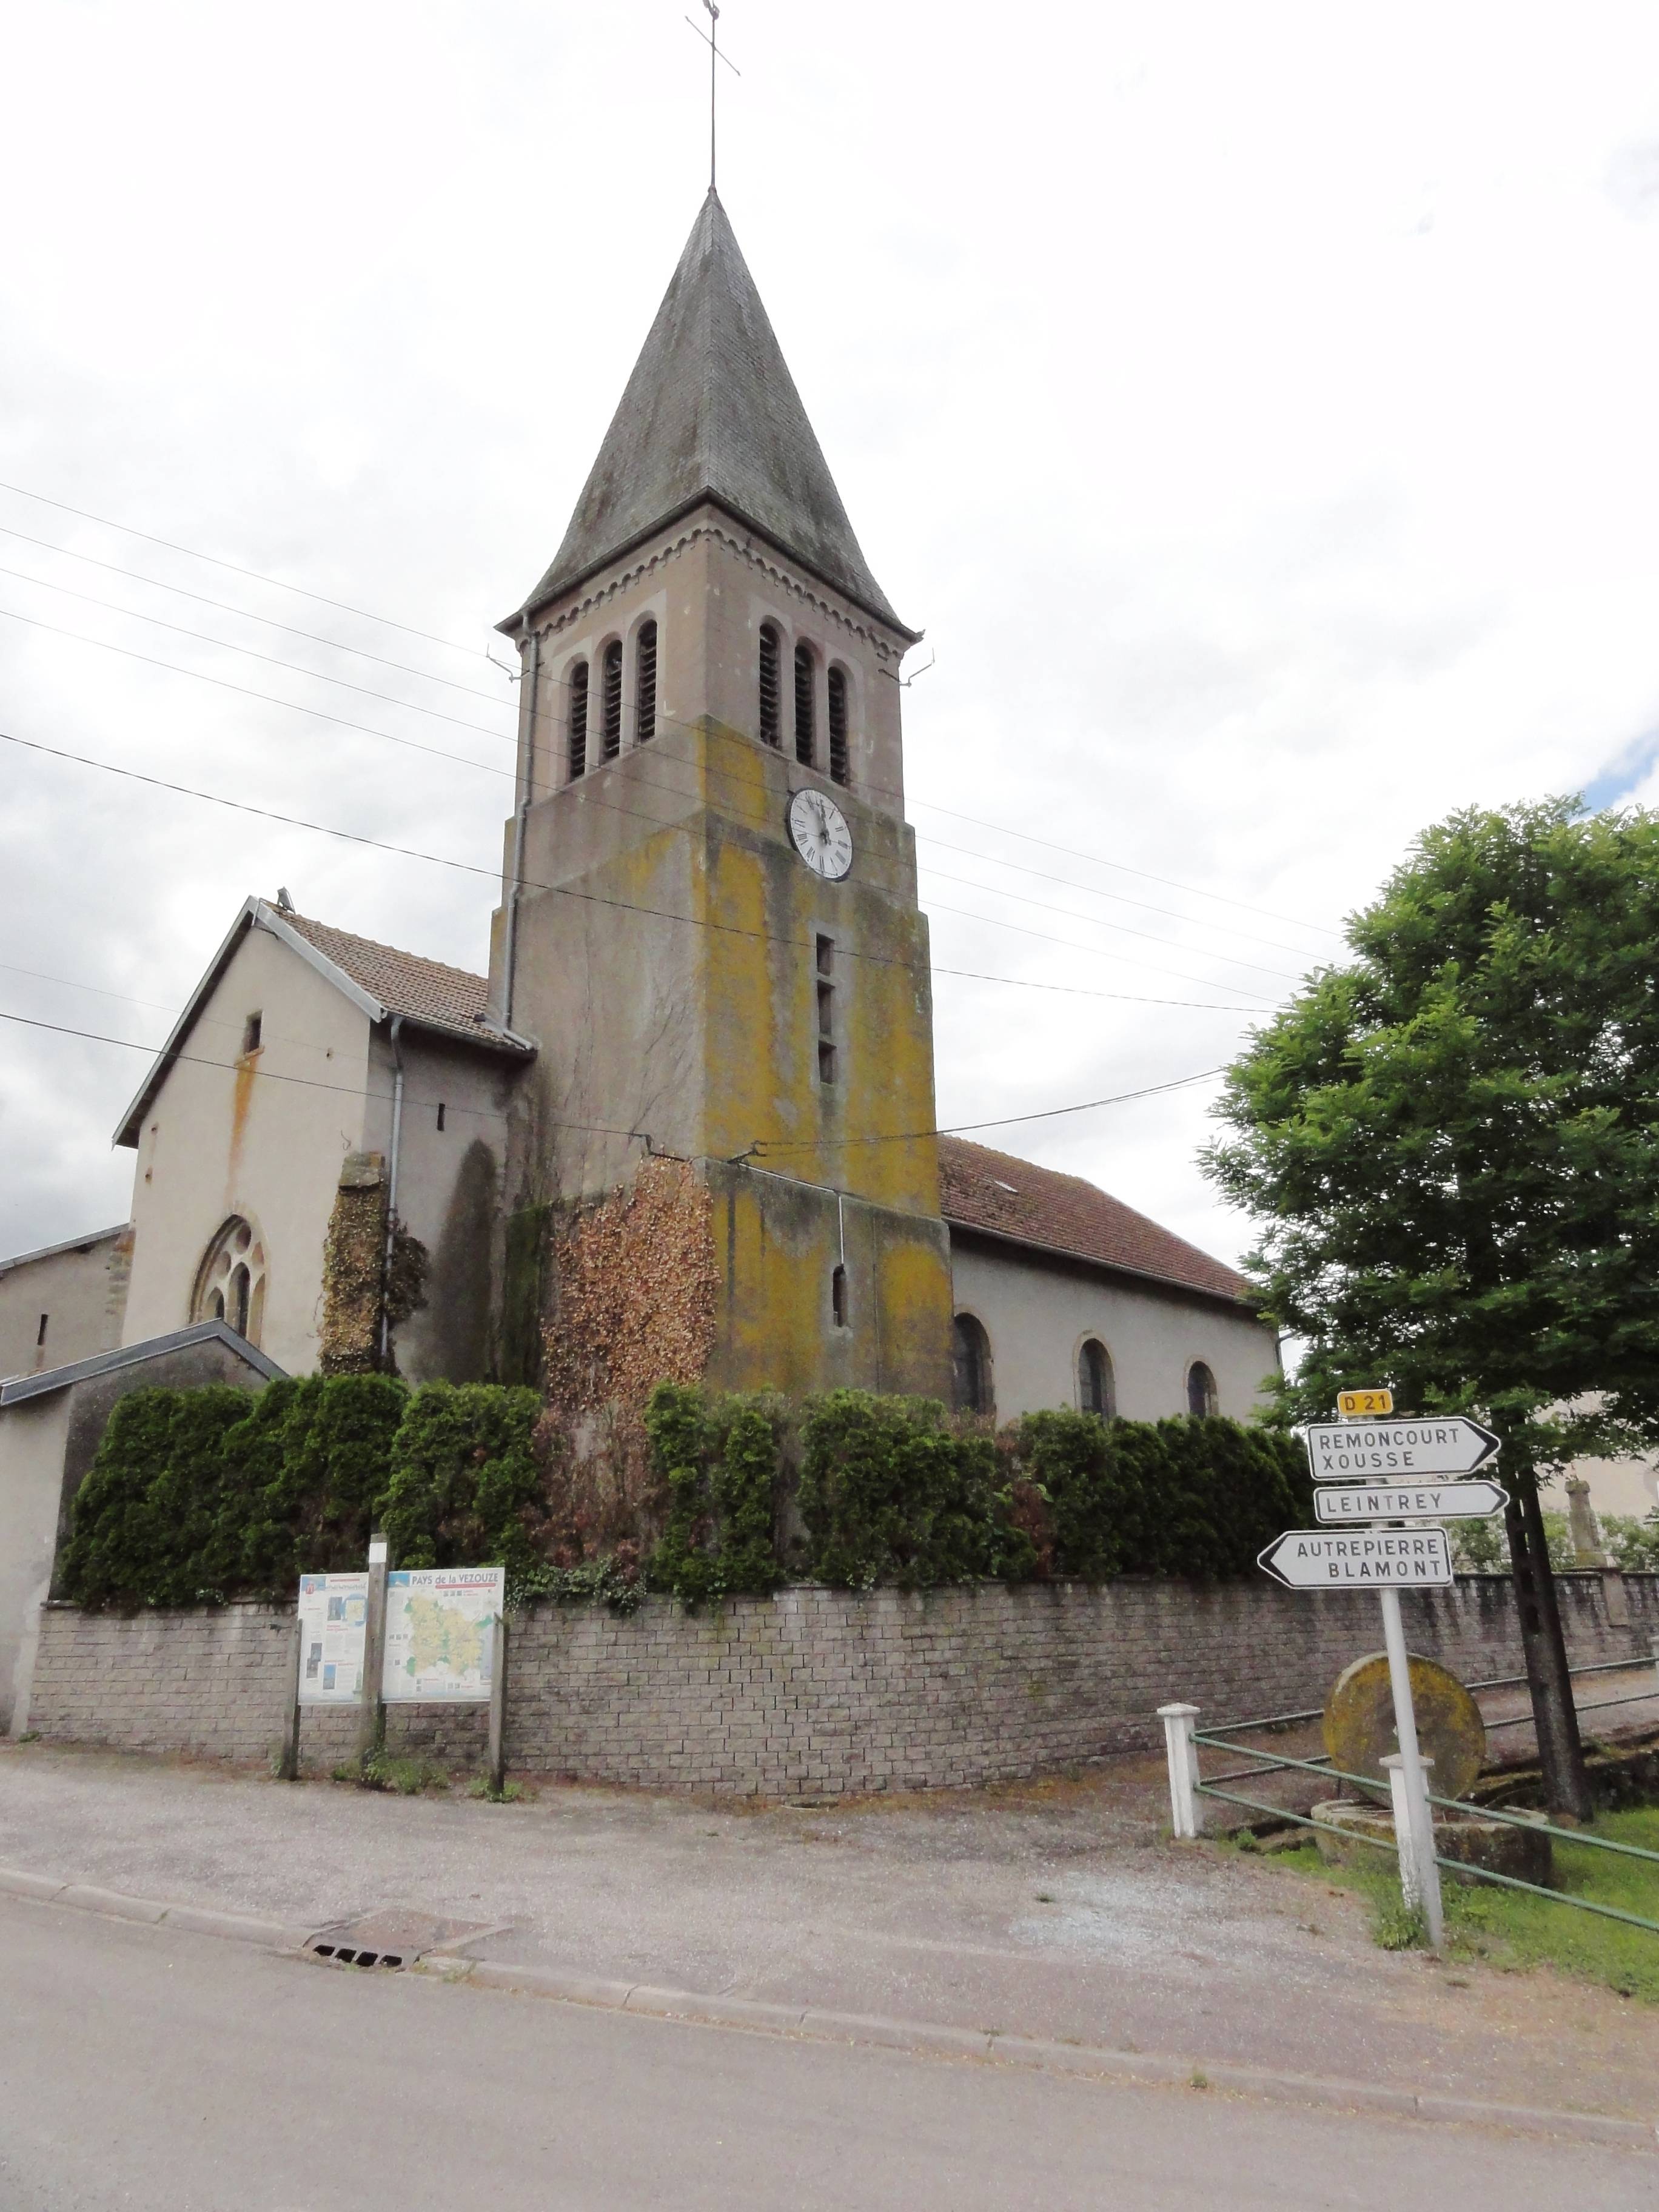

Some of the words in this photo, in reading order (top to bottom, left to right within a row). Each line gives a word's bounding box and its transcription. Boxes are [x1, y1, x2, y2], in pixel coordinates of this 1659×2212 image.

[1344, 1396, 1355, 1411] D
[1364, 1394, 1387, 1410] 21
[1319, 1428, 1459, 1450] REMONCOURT
[1323, 1451, 1415, 1470] XOUSSE
[1326, 1493, 1442, 1513] LEINTREY
[1297, 1538, 1439, 1557] AUTREPIERRE
[1329, 1560, 1441, 1578] BLAMONT
[412, 1575, 432, 1585] PAYS
[435, 1575, 446, 1584] de
[449, 1574, 456, 1584] la
[459, 1573, 498, 1583] VEZOUZE
